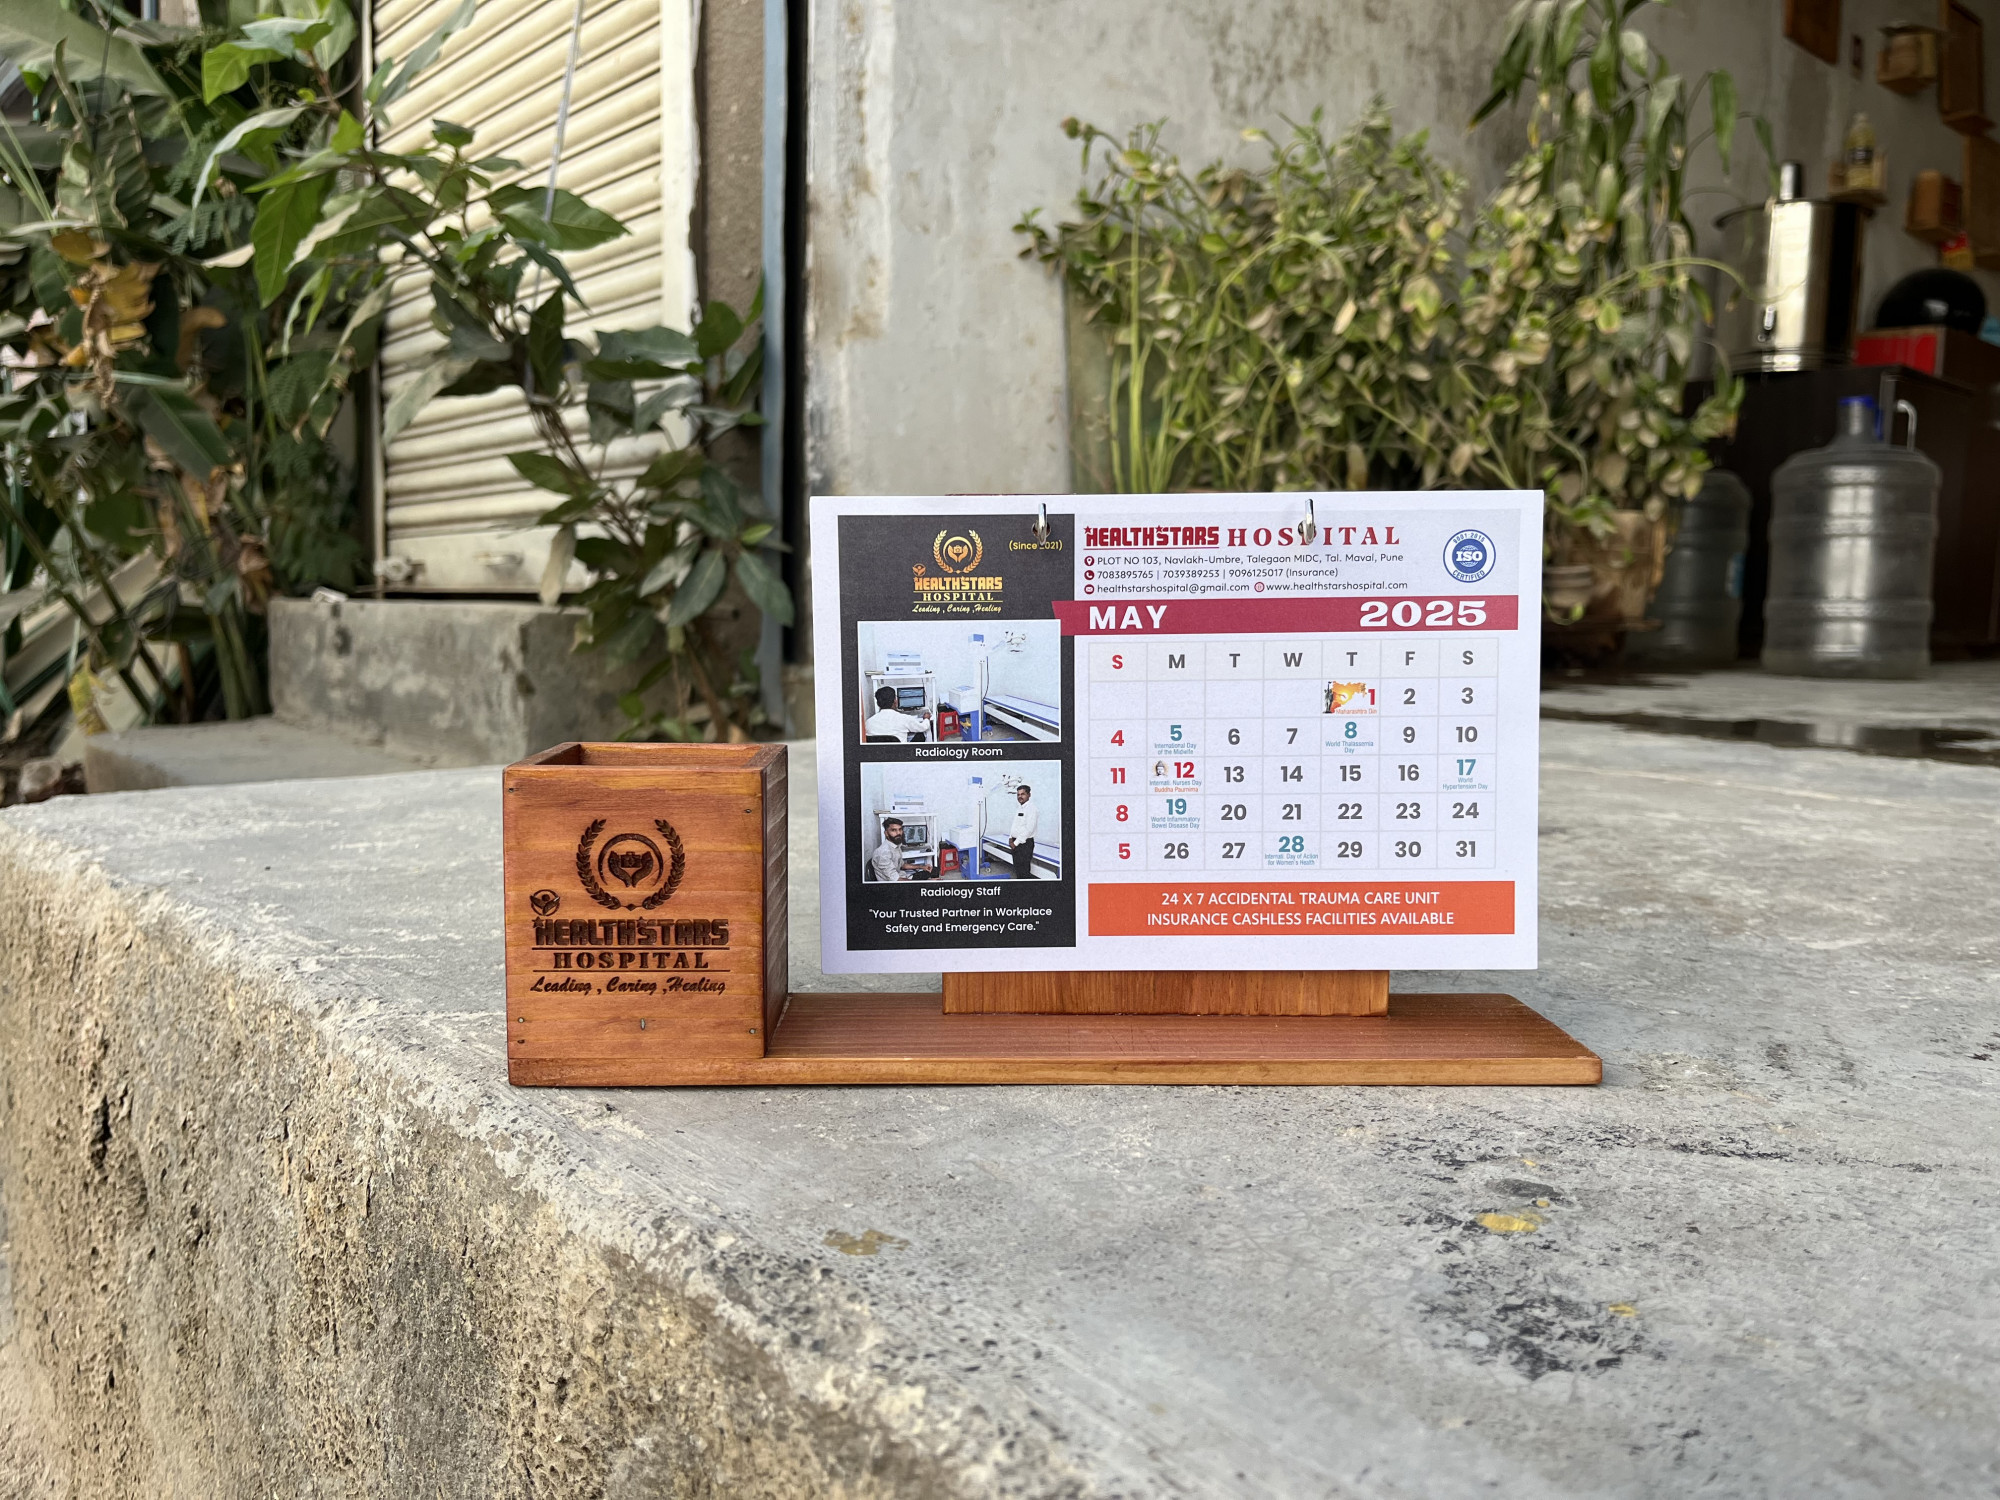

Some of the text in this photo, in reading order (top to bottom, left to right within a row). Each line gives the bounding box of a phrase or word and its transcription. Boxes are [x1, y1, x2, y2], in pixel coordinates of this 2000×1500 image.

[1084, 525, 1219, 547] HEALTHSTARS
[1008, 540, 1038, 551] (Since
[1098, 553, 1404, 566] PLOT NO 103, Navlakh-Umbre, Talegaon MIDC, Tal. Maval, Pune
[1456, 550, 1483, 562] ISO
[1097, 570, 1154, 579] 7083895765
[1163, 569, 1220, 578] 7039389253
[1228, 568, 1284, 578] 9096125017
[1286, 568, 1339, 578] (Insurance)
[1452, 569, 1486, 581] CERTIFIED
[913, 576, 1003, 591] HEALTHSTARS
[1097, 583, 1250, 594] healthstarshospital@gmail.com
[1266, 581, 1408, 592] www.healthstarshospital.com
[922, 592, 994, 602] HOSPITAL
[1089, 605, 1167, 630] MAY
[1359, 600, 1487, 627] 2025
[1112, 654, 1123, 669] S
[1168, 654, 1186, 669] M
[1229, 653, 1241, 668] T
[1283, 652, 1303, 667] W
[1346, 651, 1358, 666] T
[1405, 651, 1416, 666] F
[1462, 650, 1474, 665] S
[1367, 688, 1376, 705] 1
[1403, 688, 1416, 705] 2
[1461, 687, 1474, 704] 3
[1110, 729, 1125, 746] 4
[1170, 724, 1183, 741] 5
[1228, 728, 1241, 745] 6
[1286, 727, 1298, 744] 7
[1344, 721, 1358, 739] 8
[1403, 726, 1416, 743] 9
[1455, 726, 1478, 743] 10
[915, 747, 1003, 759] Radiology Room
[1110, 767, 1126, 784] 11
[1174, 761, 1195, 779] 12
[1224, 766, 1245, 783] 13
[1280, 765, 1304, 782] 14
[1339, 765, 1362, 782] 15
[1398, 764, 1420, 781] 16
[1456, 758, 1477, 776] 17
[1115, 804, 1129, 822] 8
[1166, 798, 1188, 815] 19
[1221, 804, 1247, 821] 20
[1281, 803, 1302, 820] 21
[1337, 803, 1363, 820] 22
[1395, 802, 1421, 819] 23
[1452, 802, 1479, 819] 24
[1118, 842, 1131, 860] 5
[1163, 842, 1190, 859] 26
[1221, 842, 1246, 859] 27
[1278, 835, 1305, 853] 28
[1337, 841, 1363, 858] 29
[1394, 840, 1422, 858] 30
[1455, 840, 1476, 858] 31
[920, 887, 1001, 899] Radiology Staff
[1161, 891, 1440, 905] 24 X 7 ACCIDENTAL TRAUMA CARE UNIT
[899, 908, 940, 918] Trusted
[942, 908, 981, 917] Partner
[983, 907, 993, 917] in
[995, 907, 1053, 918] Workplace
[1147, 912, 1454, 926] INSURANCE CASHLESS FACILITIES AVAILABLE
[531, 916, 729, 946] HEALTHSTARS
[885, 924, 919, 935] Safety
[921, 923, 943, 933] and
[945, 922, 1006, 934] Emergency
[553, 952, 709, 969] HOSPITAL
